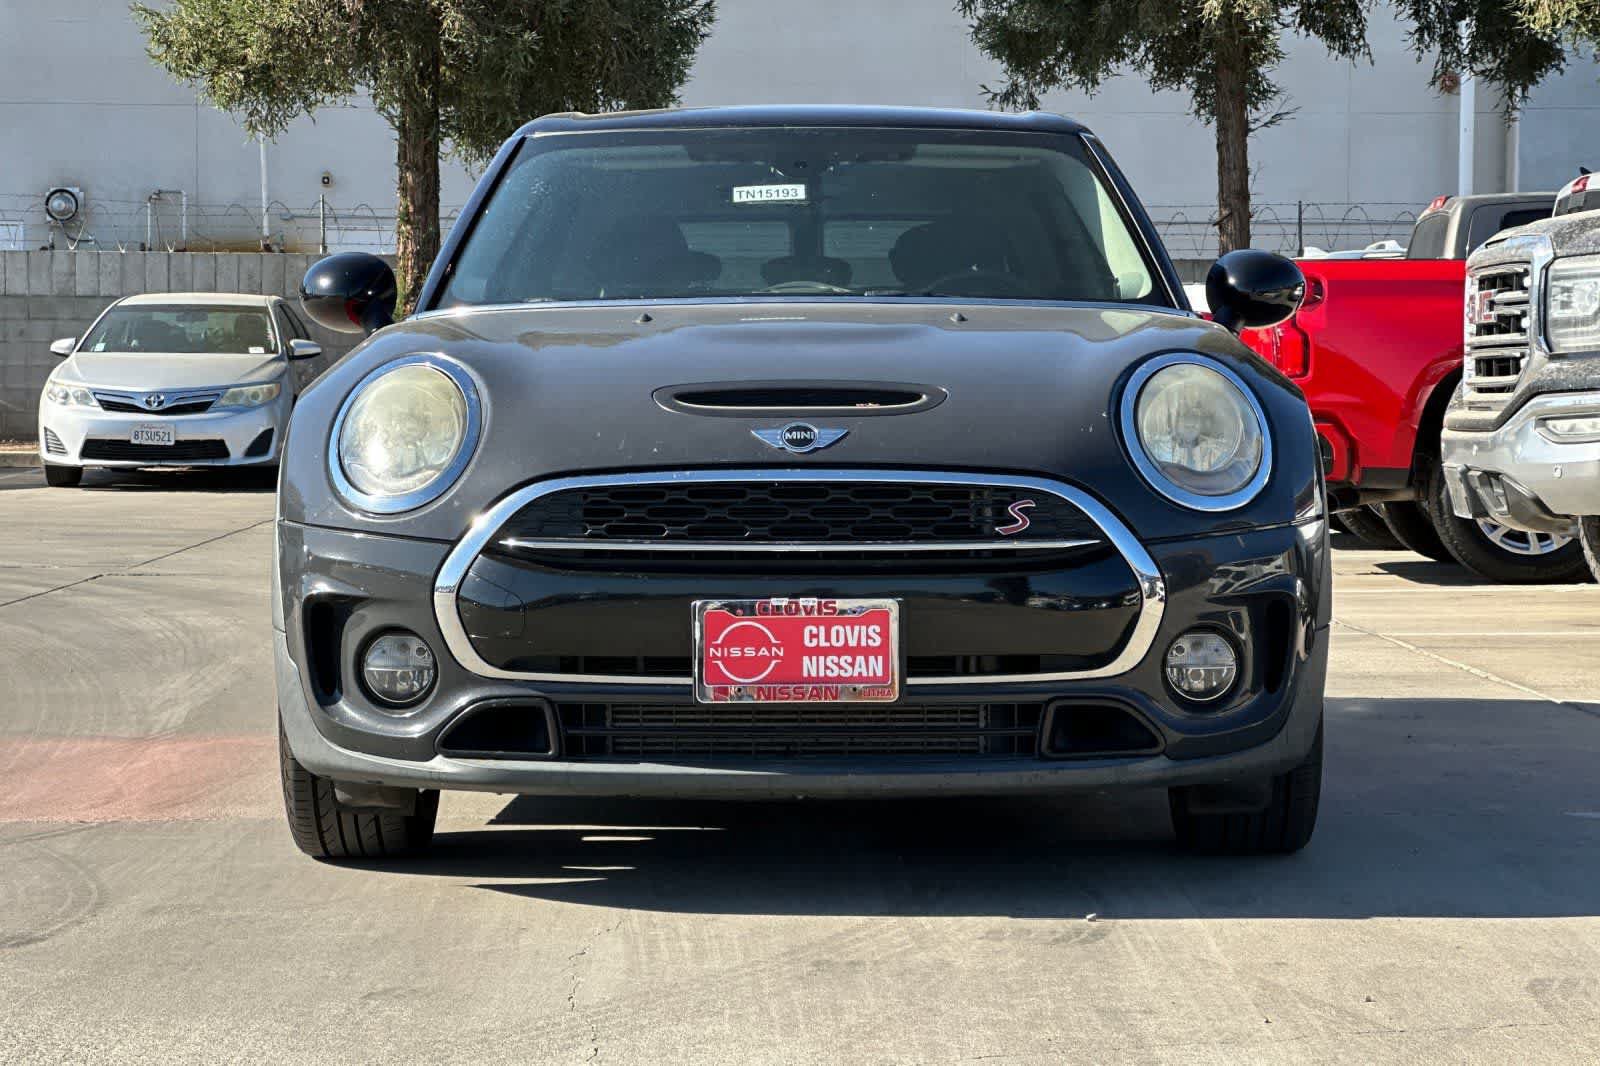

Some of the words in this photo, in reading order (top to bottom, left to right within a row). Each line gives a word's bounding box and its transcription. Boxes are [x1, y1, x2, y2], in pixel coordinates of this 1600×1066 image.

[736, 188, 798, 200] TN15193
[784, 431, 815, 440] MINI
[995, 500, 1036, 535] S
[755, 600, 838, 616] CLOVIS
[803, 625, 882, 647] CLOVIS
[709, 647, 784, 657] NISSAN
[802, 655, 883, 678] NISSAN
[754, 686, 839, 701] NISSAN
